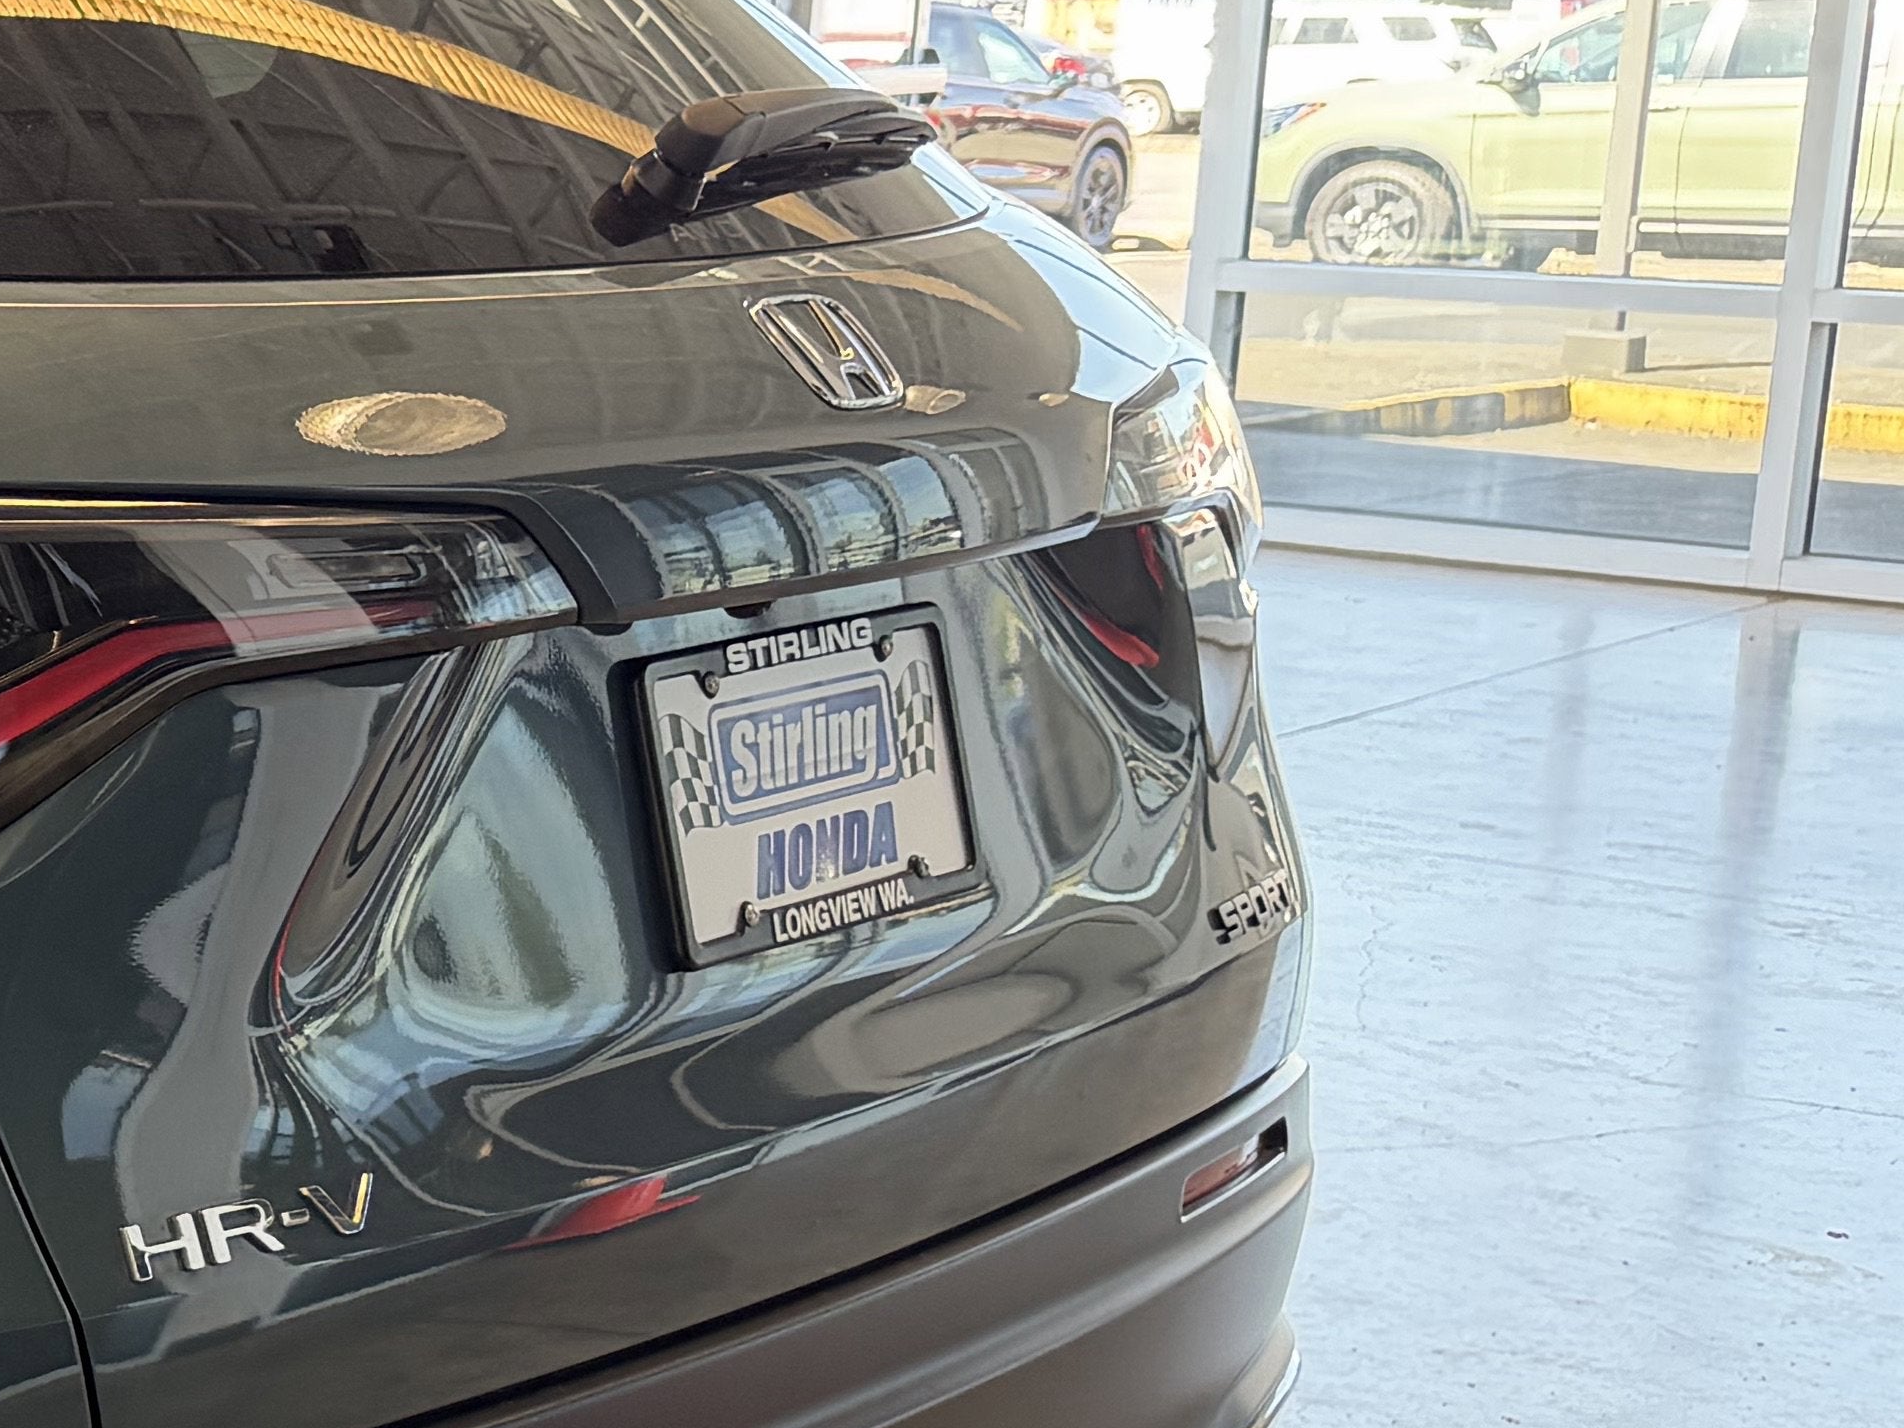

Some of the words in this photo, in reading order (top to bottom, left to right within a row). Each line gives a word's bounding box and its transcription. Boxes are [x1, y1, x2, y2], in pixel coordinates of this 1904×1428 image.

[726, 618, 873, 673] STIRLING
[730, 703, 878, 798] Stirling
[757, 801, 898, 900] HONDA
[773, 886, 878, 942] LONGVIEW
[119, 1172, 374, 1282] HR-V
